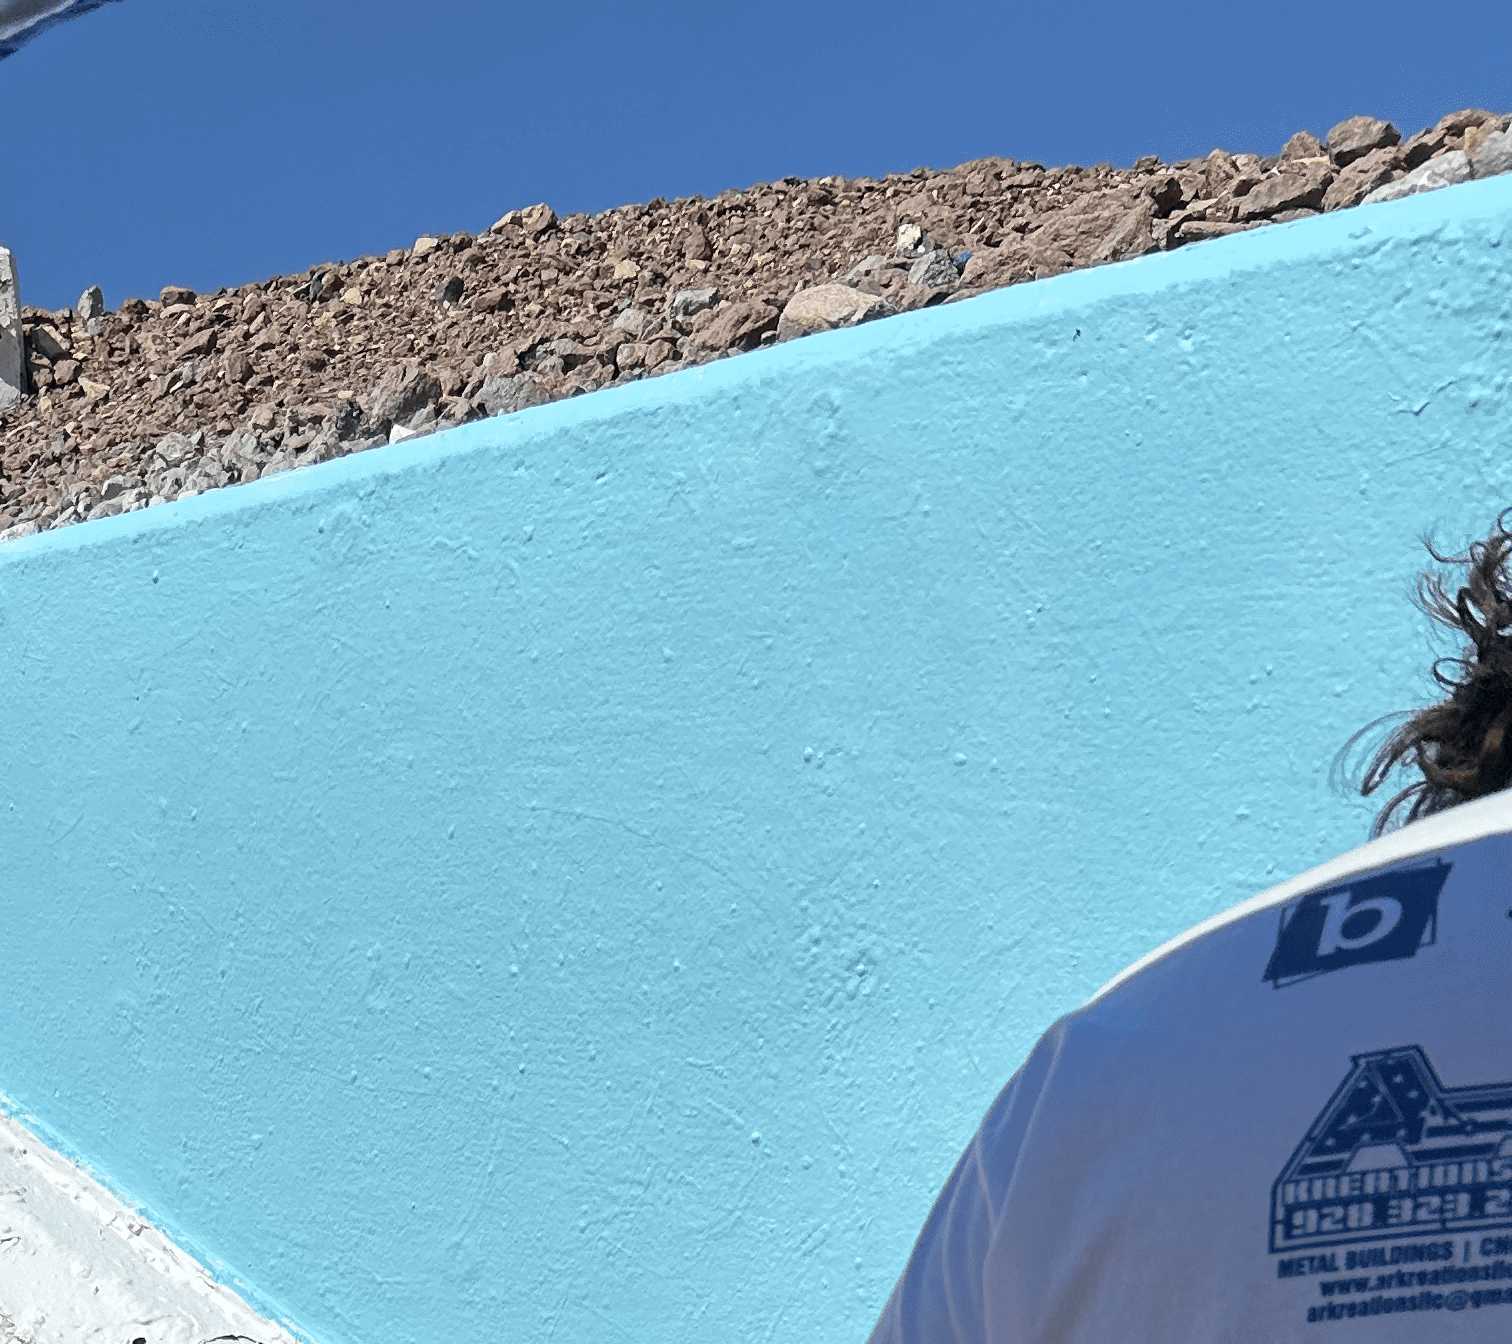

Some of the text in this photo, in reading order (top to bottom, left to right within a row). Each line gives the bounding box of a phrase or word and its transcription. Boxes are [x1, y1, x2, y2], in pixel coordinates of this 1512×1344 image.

[1317, 890, 1402, 957] b
[1278, 1253, 1340, 1279] METAL
[1345, 1240, 1453, 1270] BUILDINGS
